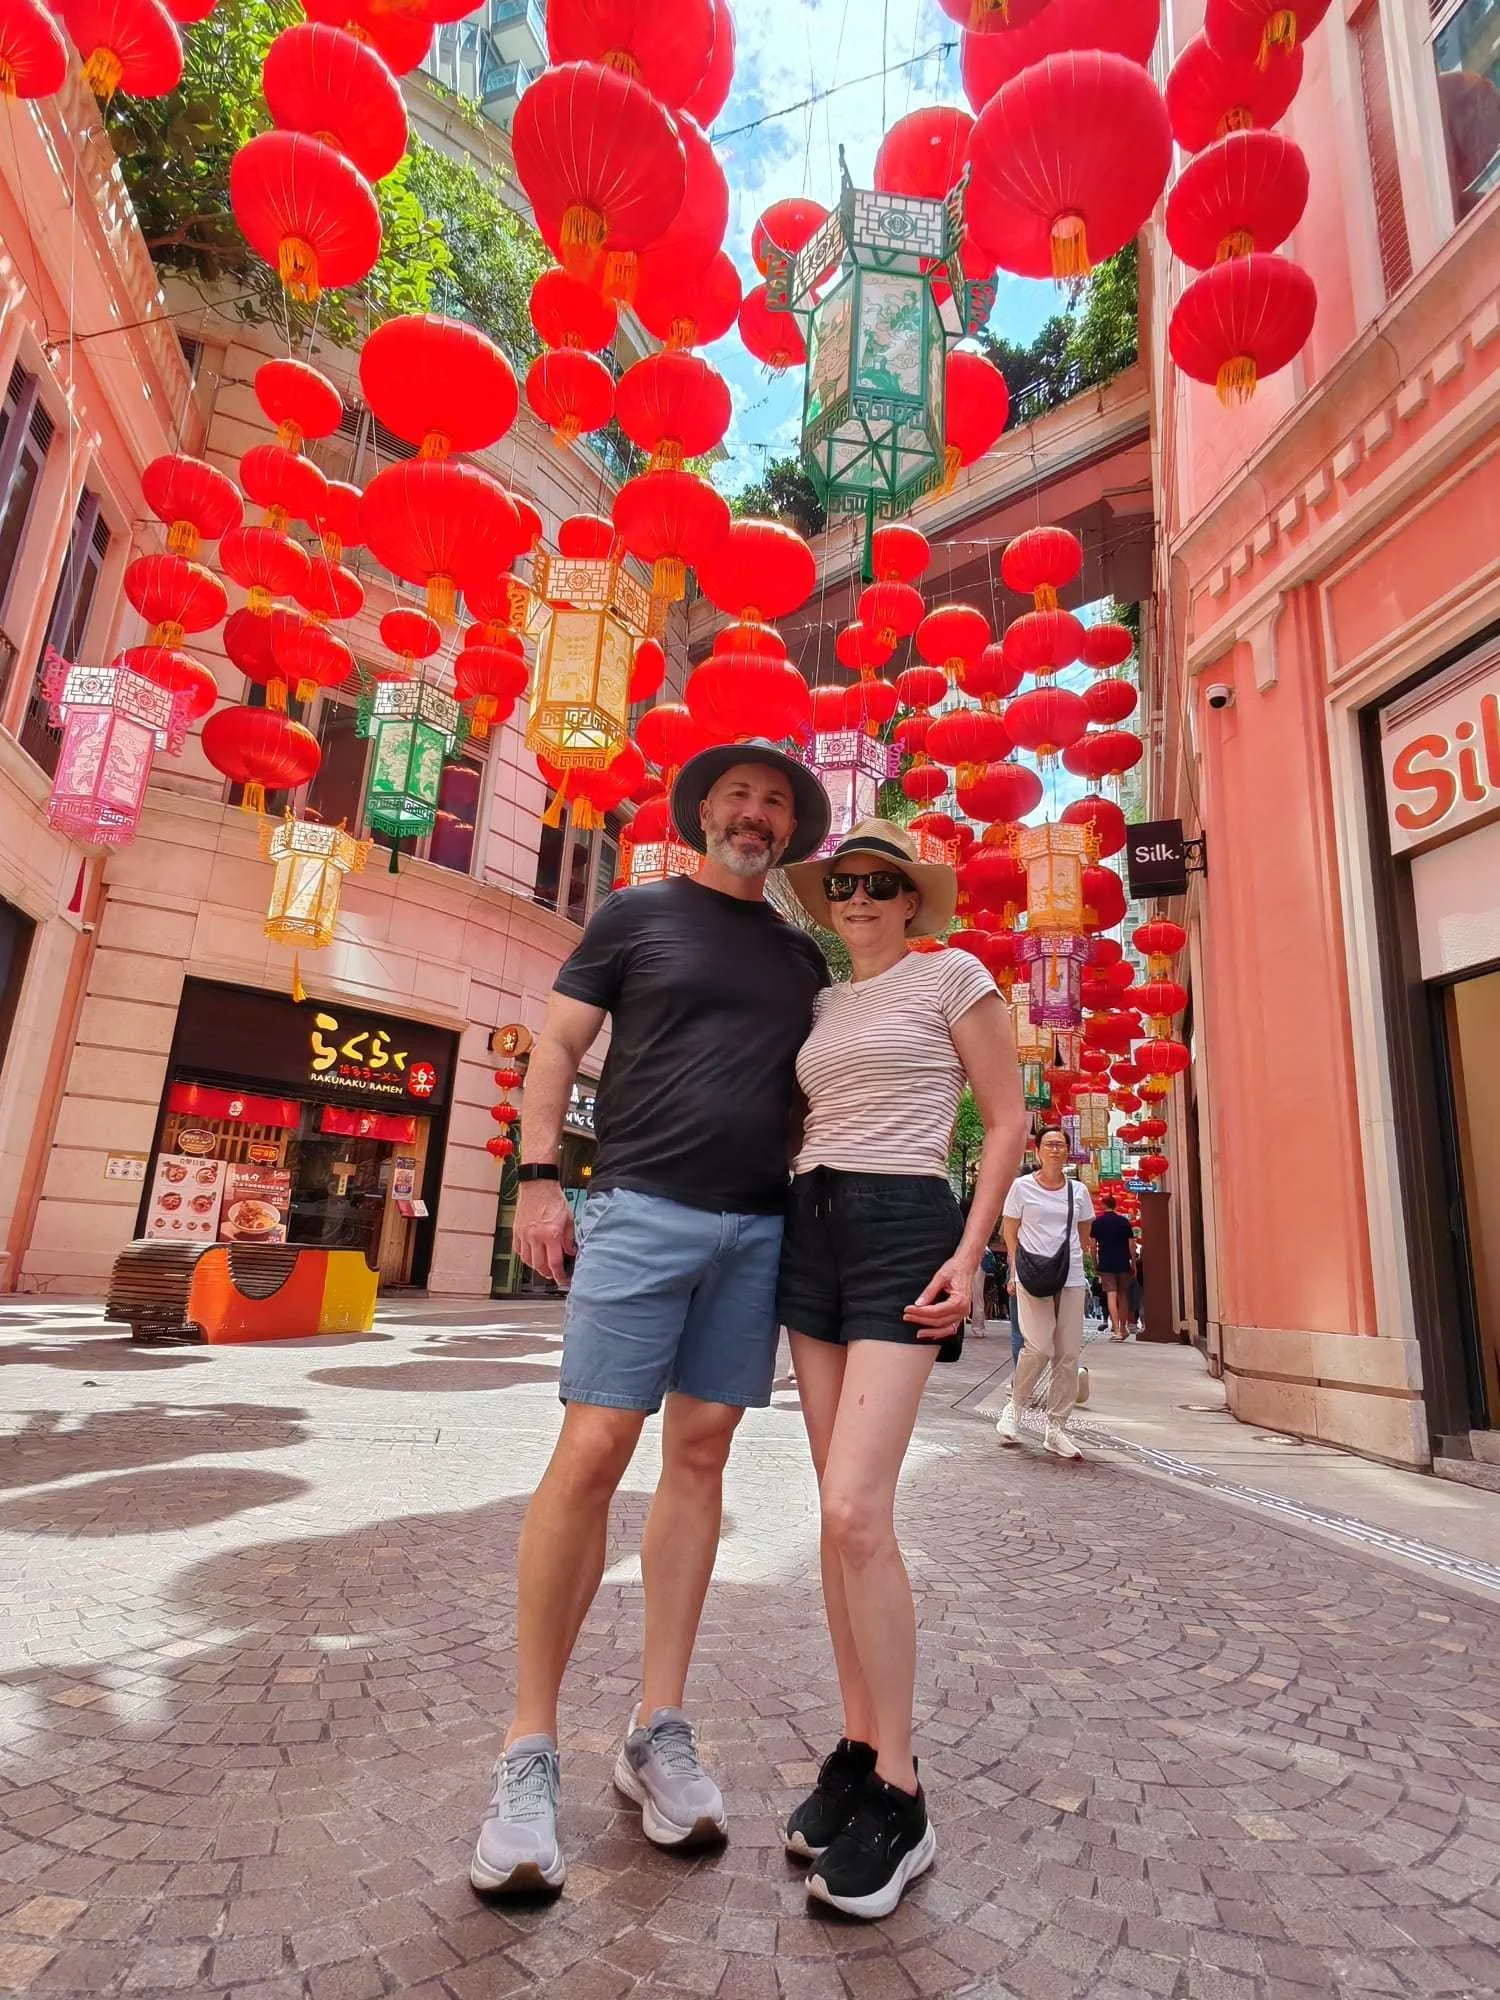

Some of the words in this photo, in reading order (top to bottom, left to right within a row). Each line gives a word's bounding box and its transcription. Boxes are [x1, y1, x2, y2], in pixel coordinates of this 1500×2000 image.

[1135, 844, 1180, 863] Silk.
[311, 1013, 408, 1071] らくらく
[310, 1072, 367, 1089] RAKURAKU
[369, 1081, 403, 1095] RAMEN
